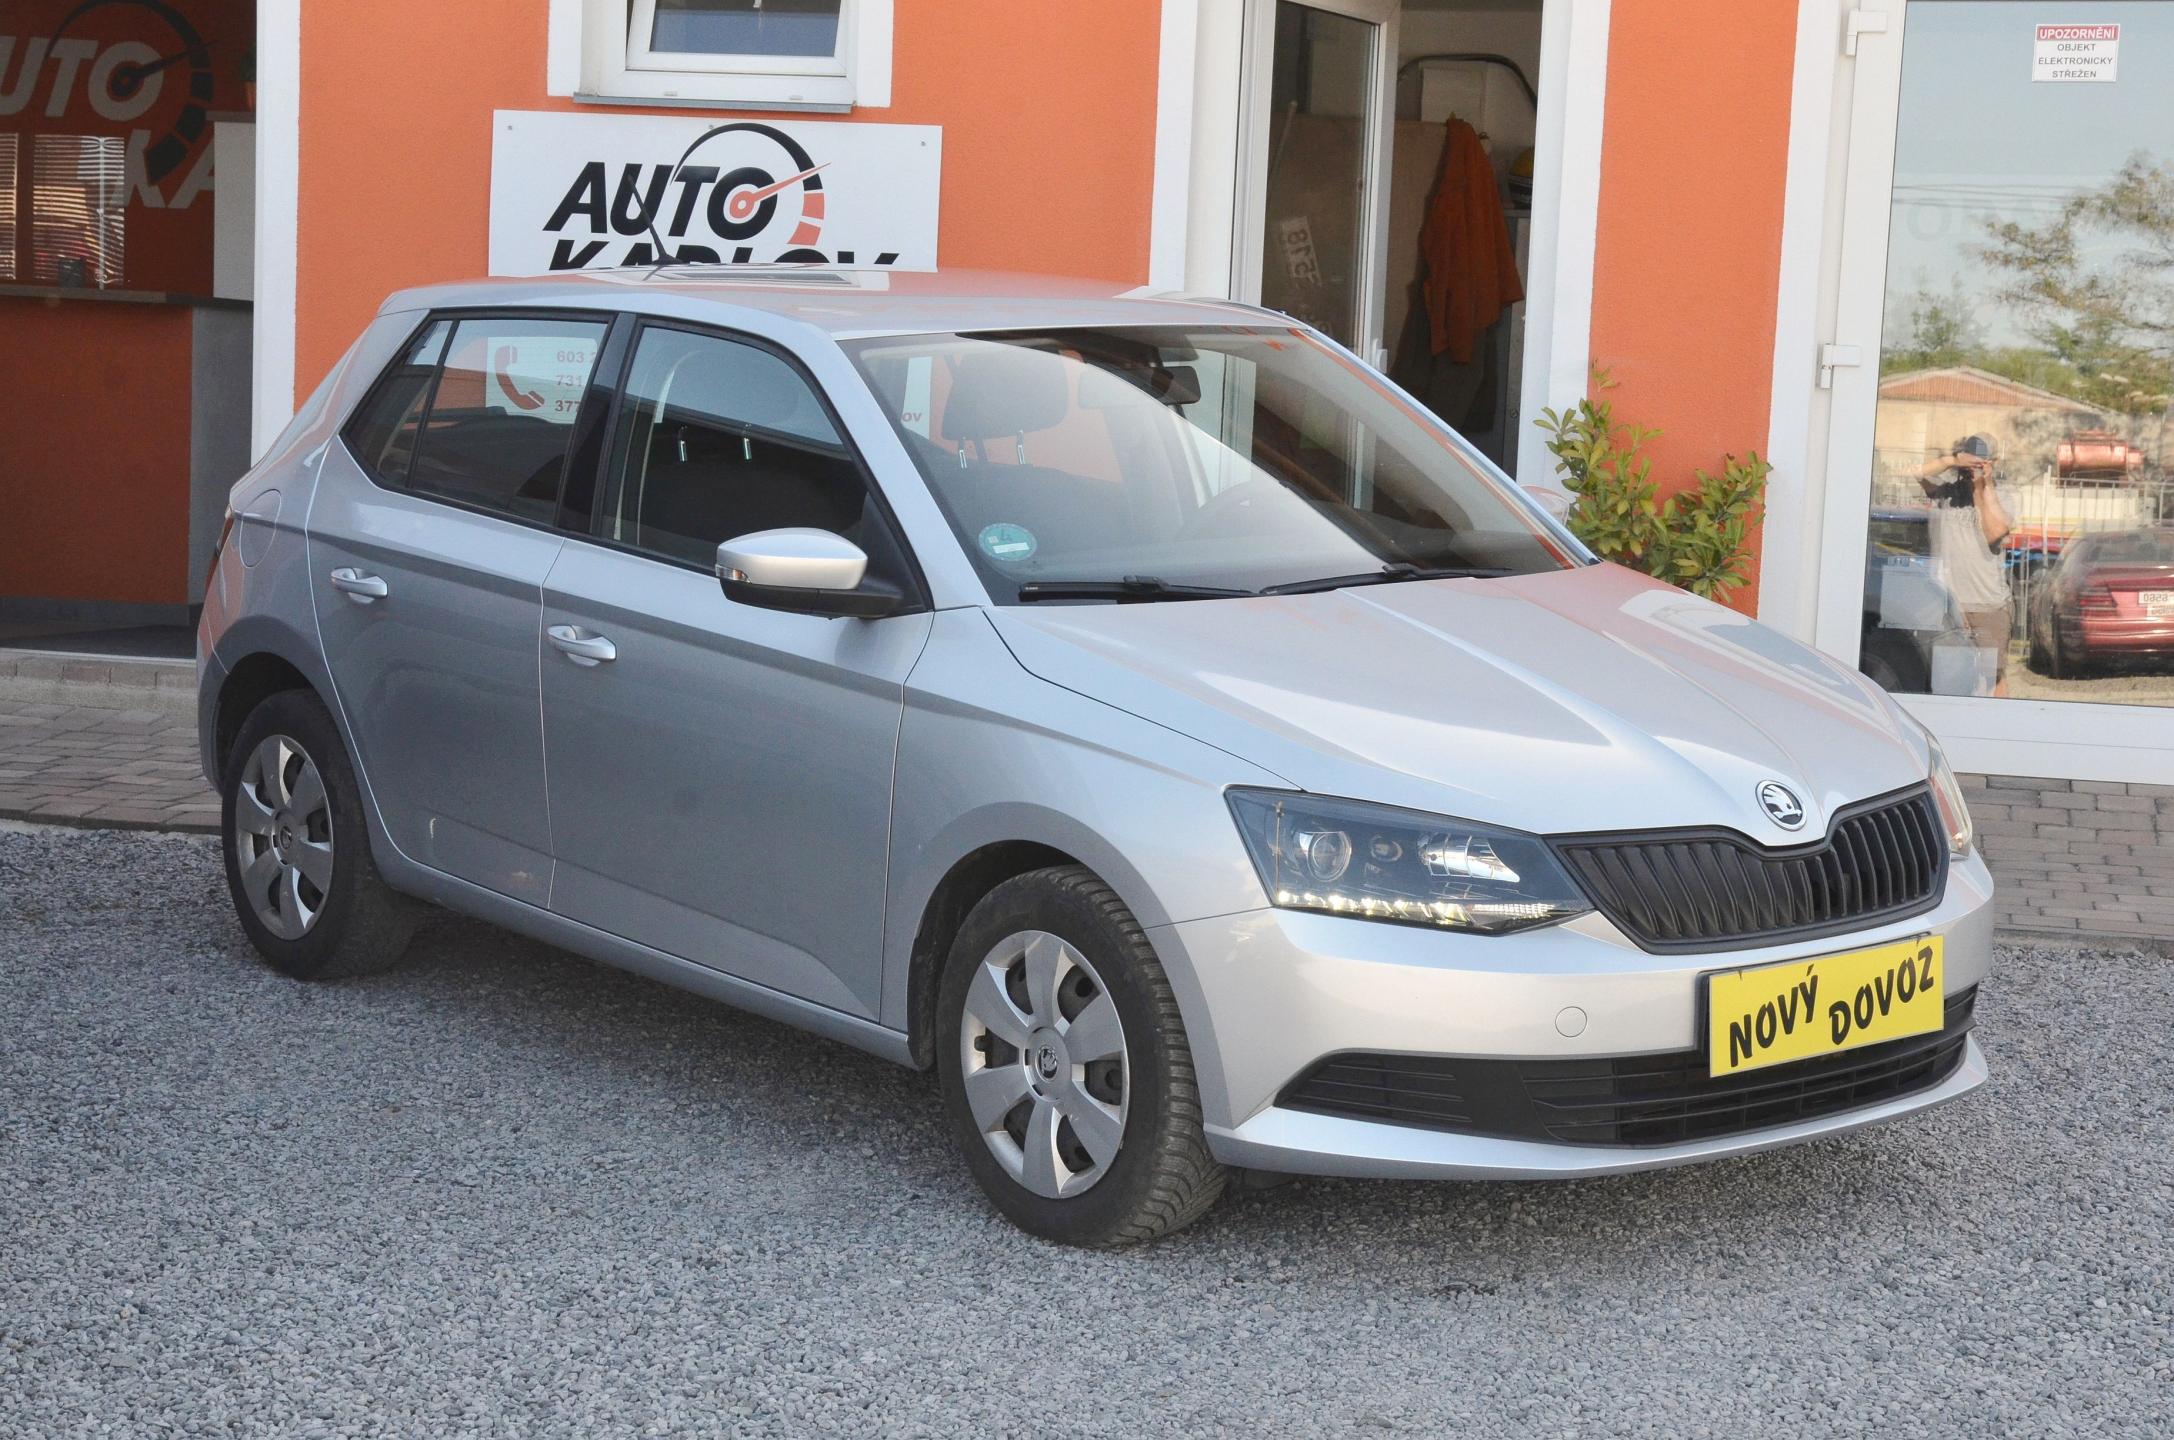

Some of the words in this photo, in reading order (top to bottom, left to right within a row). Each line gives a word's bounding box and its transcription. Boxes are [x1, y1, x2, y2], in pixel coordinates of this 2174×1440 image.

[2039, 26, 2116, 40] UPOZORNĚNÍ
[2056, 43, 2097, 52] OBJEKT
[2037, 56, 2114, 66] ELEKTRONICKY
[2051, 68, 2098, 79] STŘEŽEN
[543, 161, 779, 241] AUTO
[556, 350, 585, 364] 603
[1729, 964, 1819, 1068] NOVÝ
[1829, 945, 1935, 1046] DOVOZ
